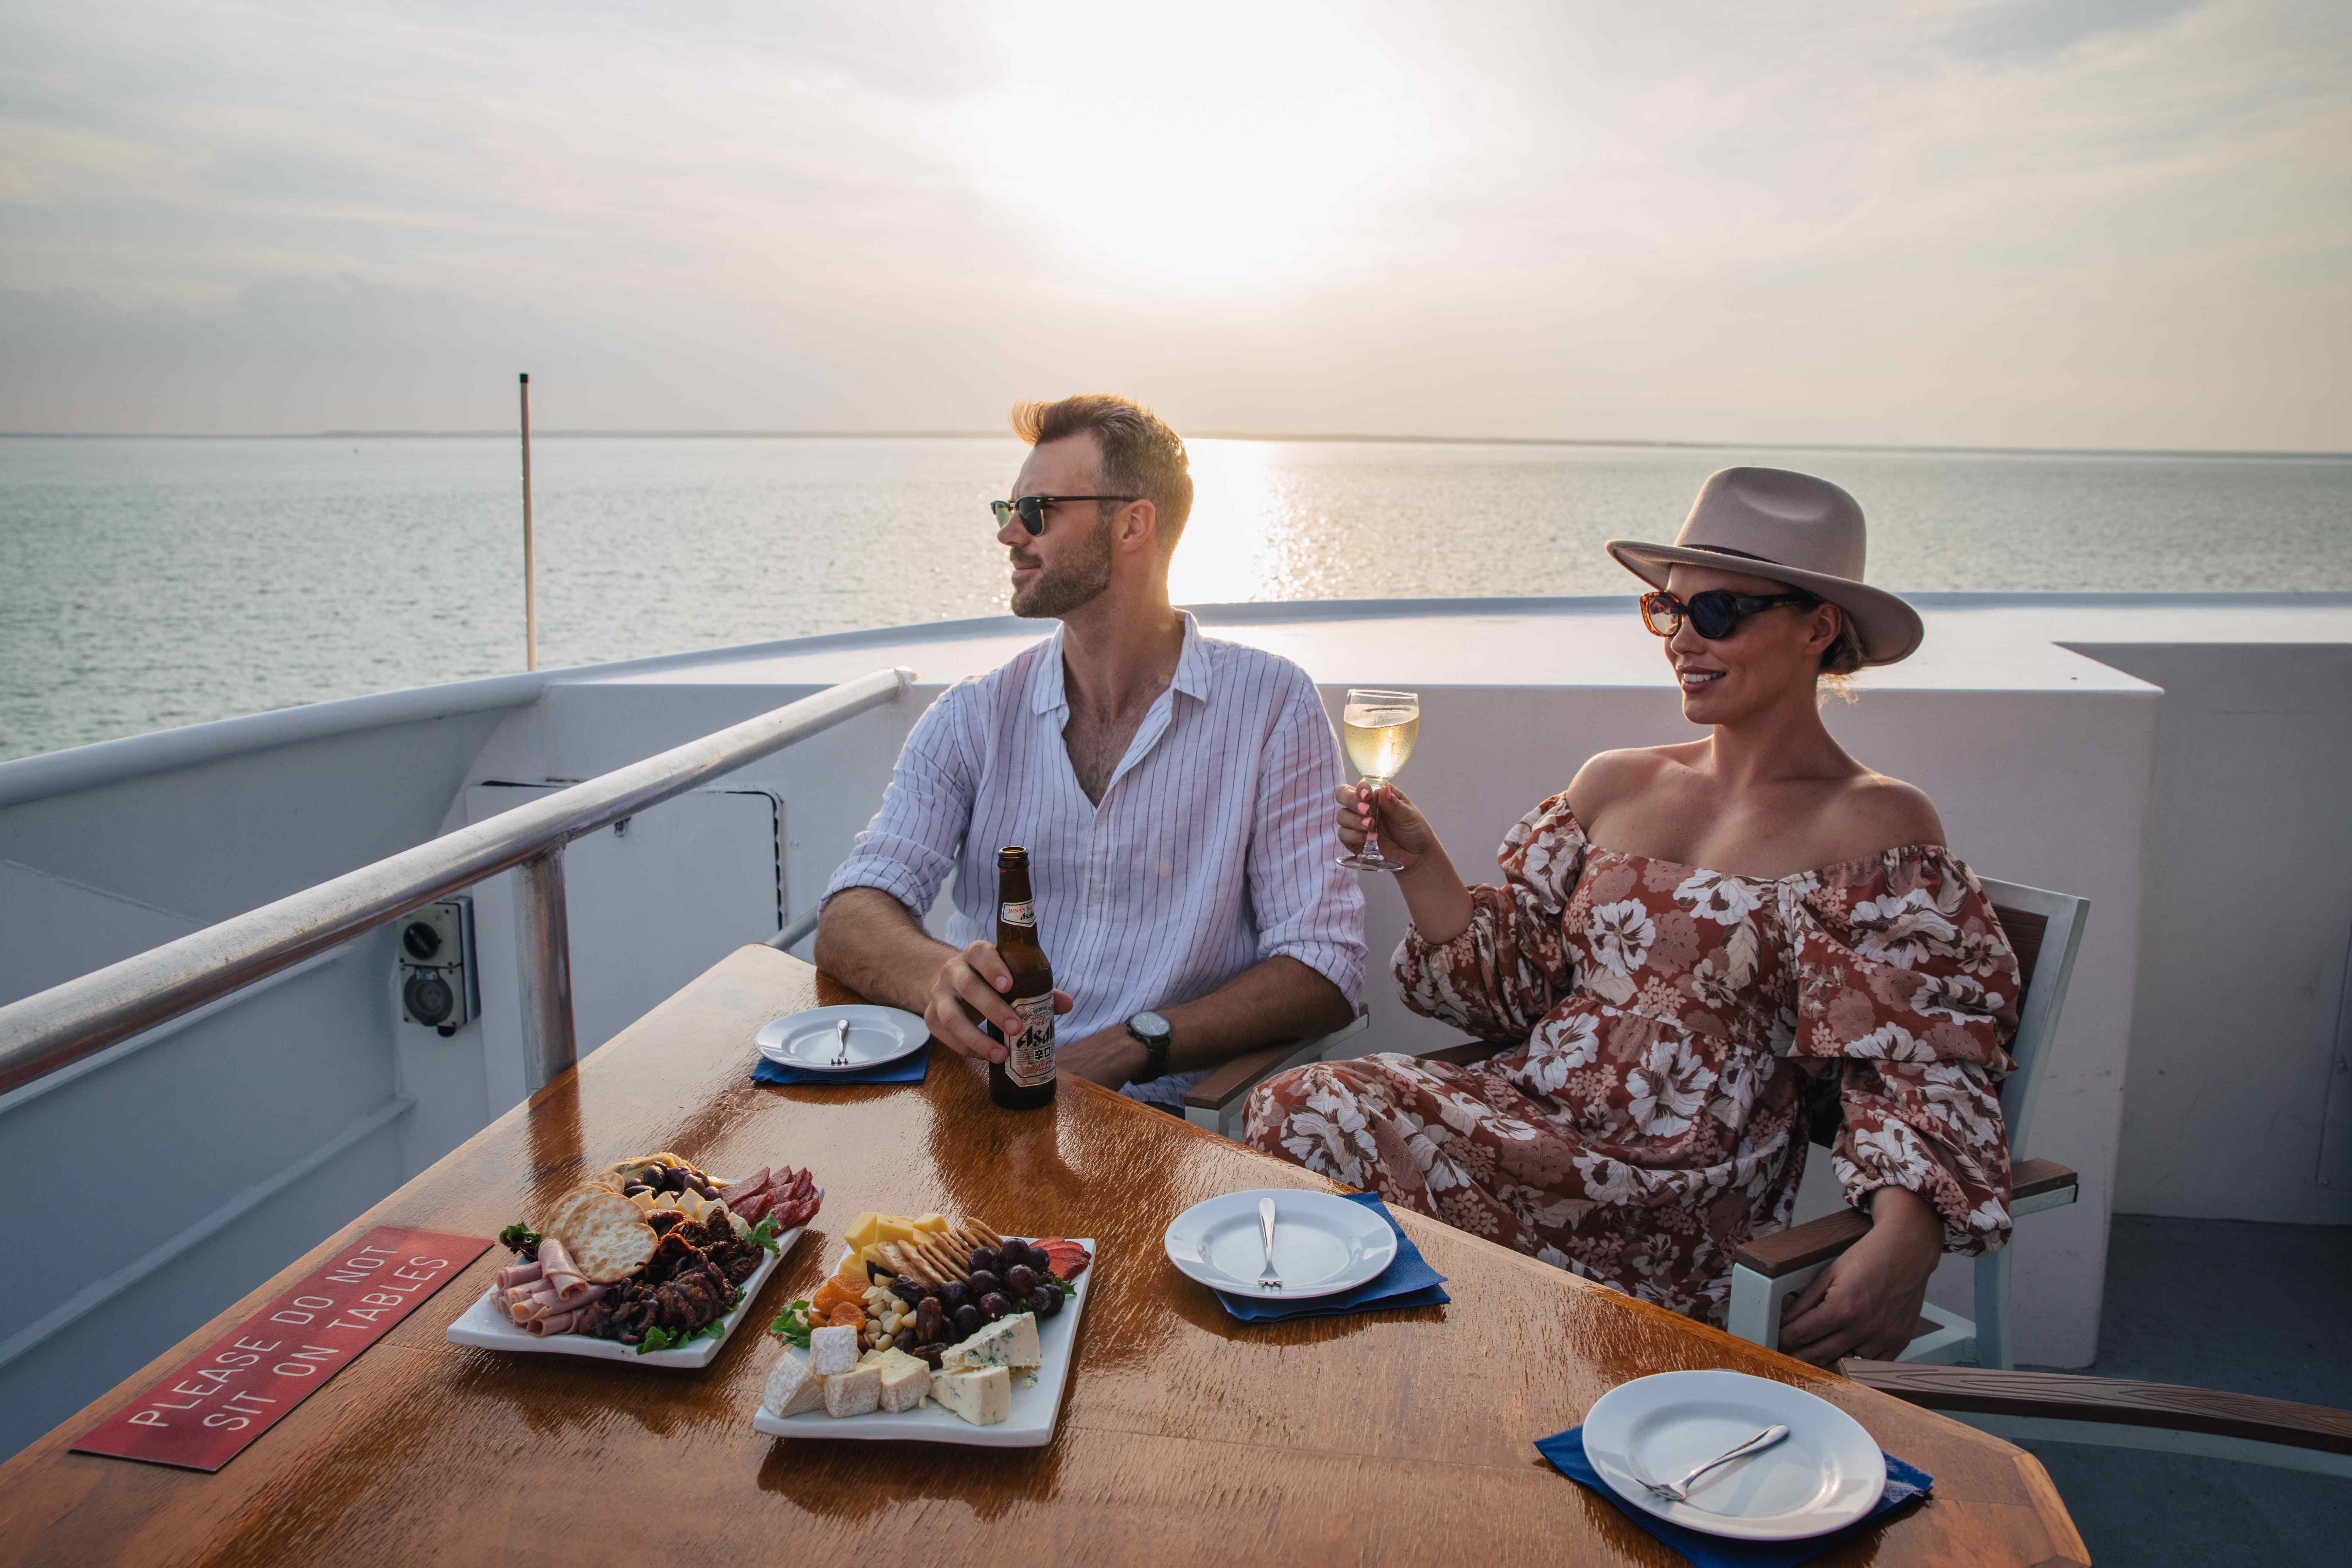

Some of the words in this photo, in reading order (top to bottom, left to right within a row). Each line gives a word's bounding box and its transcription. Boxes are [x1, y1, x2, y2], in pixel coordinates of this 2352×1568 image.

[1016, 1018, 1054, 1048] Asah
[1034, 1046, 1051, 1060] 辛口
[128, 1335, 283, 1427] PLEASE
[270, 1295, 333, 1325] DO
[325, 1245, 399, 1283] NOT
[202, 1390, 276, 1431] SIT
[272, 1345, 340, 1377] ON
[328, 1256, 449, 1329] TABLES
